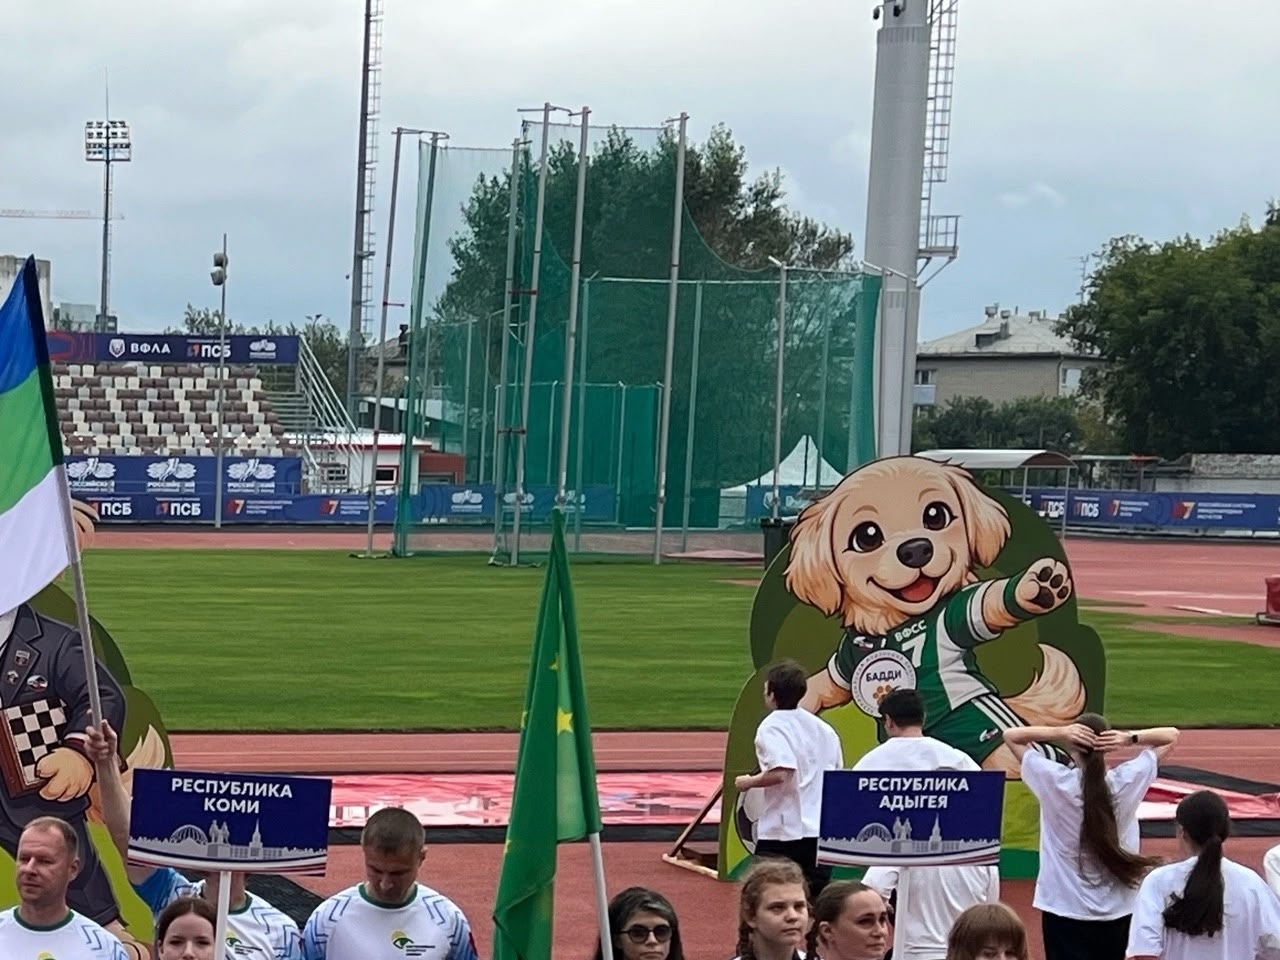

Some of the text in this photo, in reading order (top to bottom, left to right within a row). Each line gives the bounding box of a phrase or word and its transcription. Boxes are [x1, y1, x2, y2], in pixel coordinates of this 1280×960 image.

[130, 342, 171, 354] ВФЛА
[201, 344, 232, 358] ПСБ
[101, 502, 132, 516] ПСБ
[170, 503, 201, 516] ПСБ
[1080, 502, 1099, 518] ПСБ
[901, 631, 927, 668] 7
[865, 670, 902, 682] БАДДИ
[171, 778, 293, 798] РЕСПУБЛИКА
[858, 777, 970, 791] РЕСПУБЛИКА
[203, 798, 260, 814] КОМИ
[879, 795, 948, 811] АДЫГЕЯ
